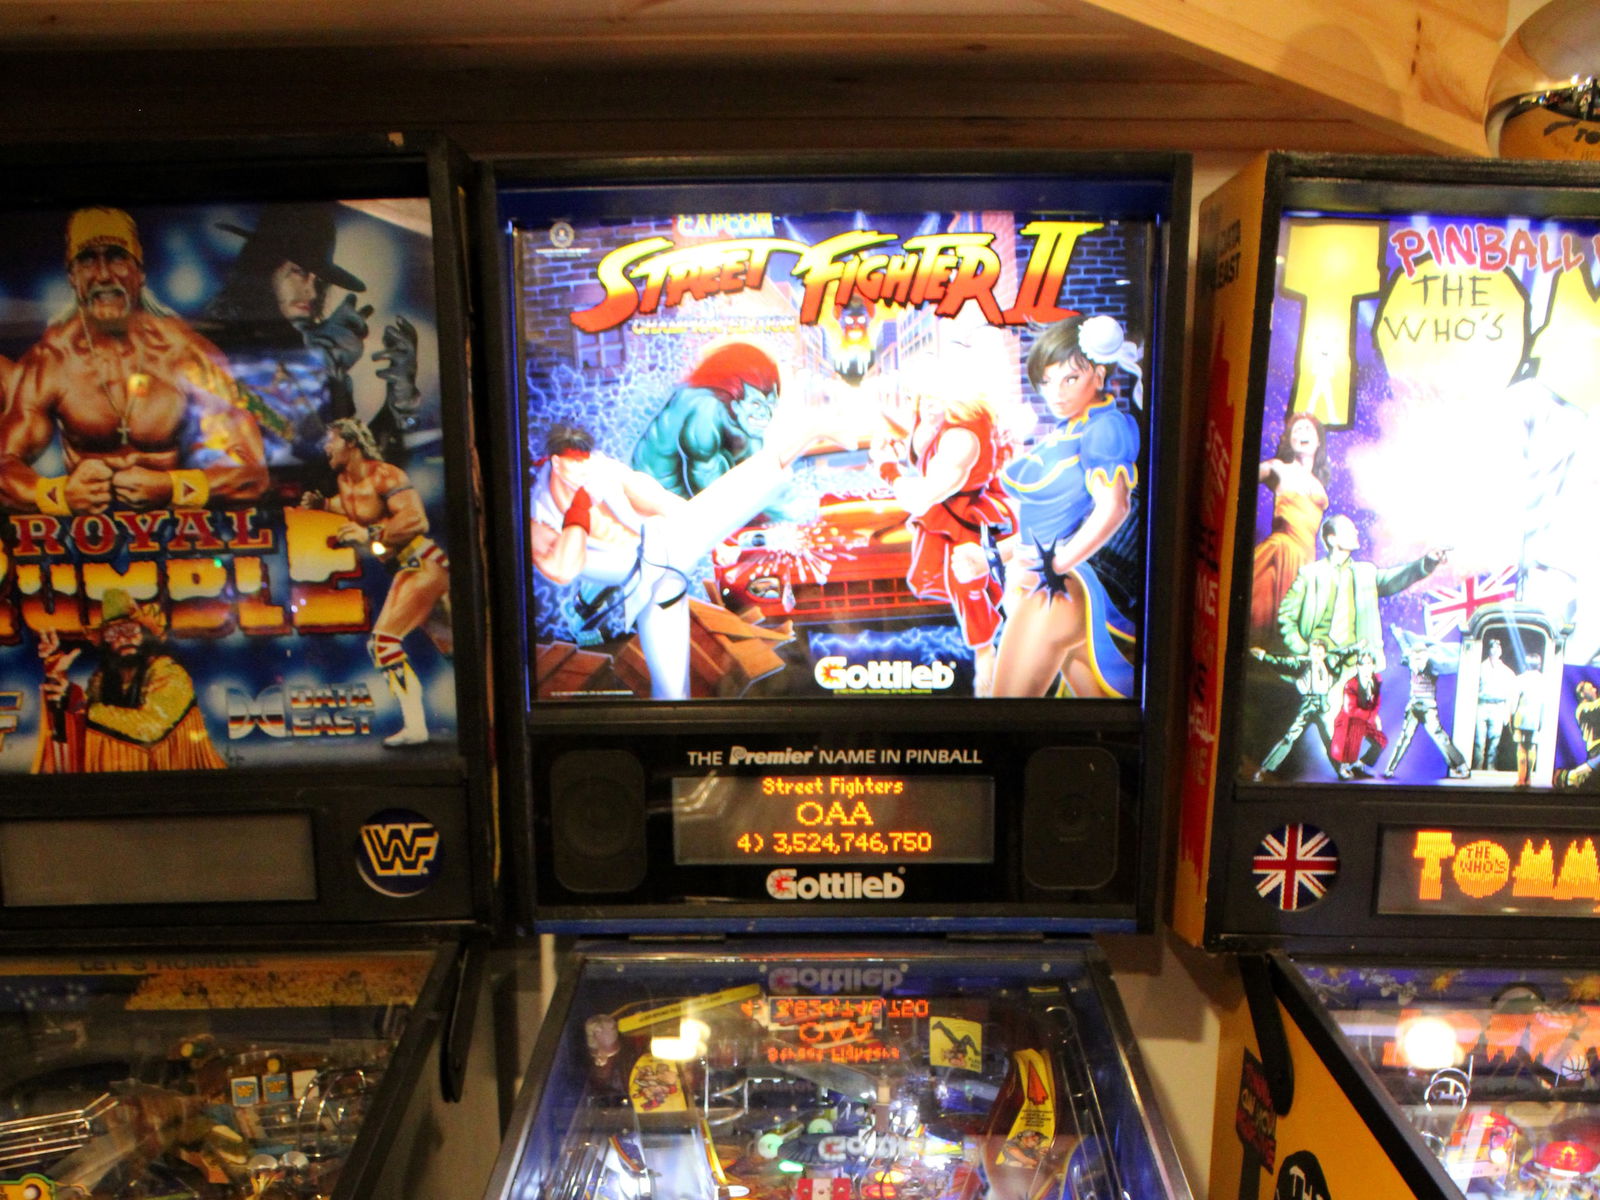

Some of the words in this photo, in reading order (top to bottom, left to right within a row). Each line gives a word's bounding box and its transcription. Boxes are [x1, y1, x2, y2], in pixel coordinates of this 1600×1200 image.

[677, 213, 774, 236] CAPCOM
[1390, 223, 1584, 279] PINBALL
[570, 237, 803, 333] STREET
[791, 230, 1004, 326] FIGHTER
[1411, 273, 1492, 307] THE
[1384, 312, 1505, 343] WHO'S
[10, 507, 276, 557] ROYAL
[814, 655, 955, 689] Gottlieb
[289, 684, 376, 708] DATA
[289, 711, 373, 736] EAST
[688, 751, 722, 766] THE
[729, 746, 814, 765] Premier
[819, 750, 875, 764] NAME
[881, 750, 900, 764] IN
[906, 750, 983, 764] PINBALL
[762, 777, 823, 795] Street
[830, 777, 903, 799] Fighters
[797, 801, 873, 826] OAA
[737, 832, 764, 853] 4)
[773, 832, 932, 855] 3,524,746,750
[766, 868, 905, 899] Gottlieb
